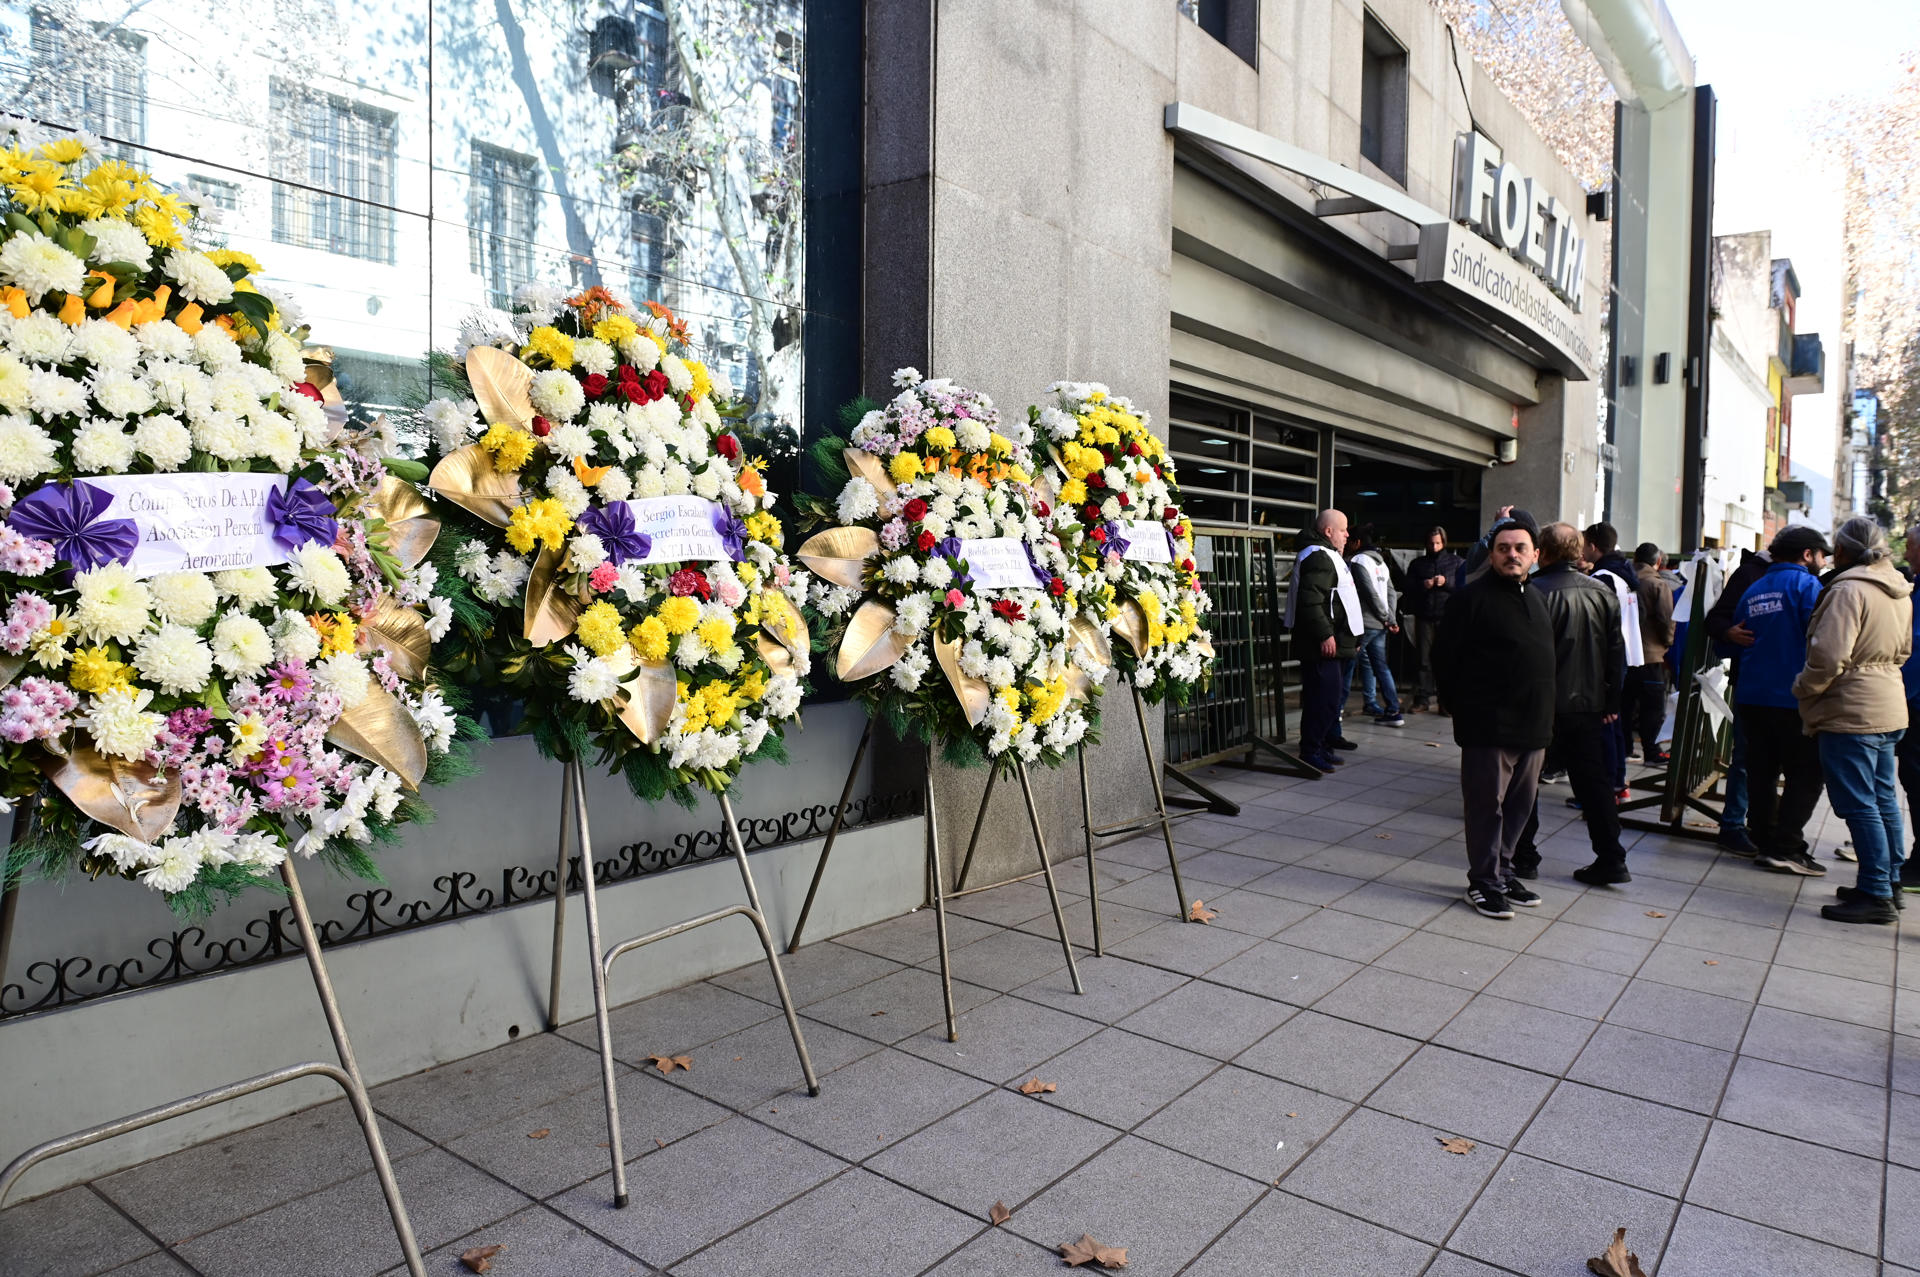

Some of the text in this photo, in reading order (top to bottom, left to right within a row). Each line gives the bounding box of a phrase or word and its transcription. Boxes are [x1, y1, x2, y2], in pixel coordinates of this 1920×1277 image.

[1463, 131, 1586, 314] FOETRA
[222, 488, 239, 507] De
[643, 504, 676, 523] Sergio
